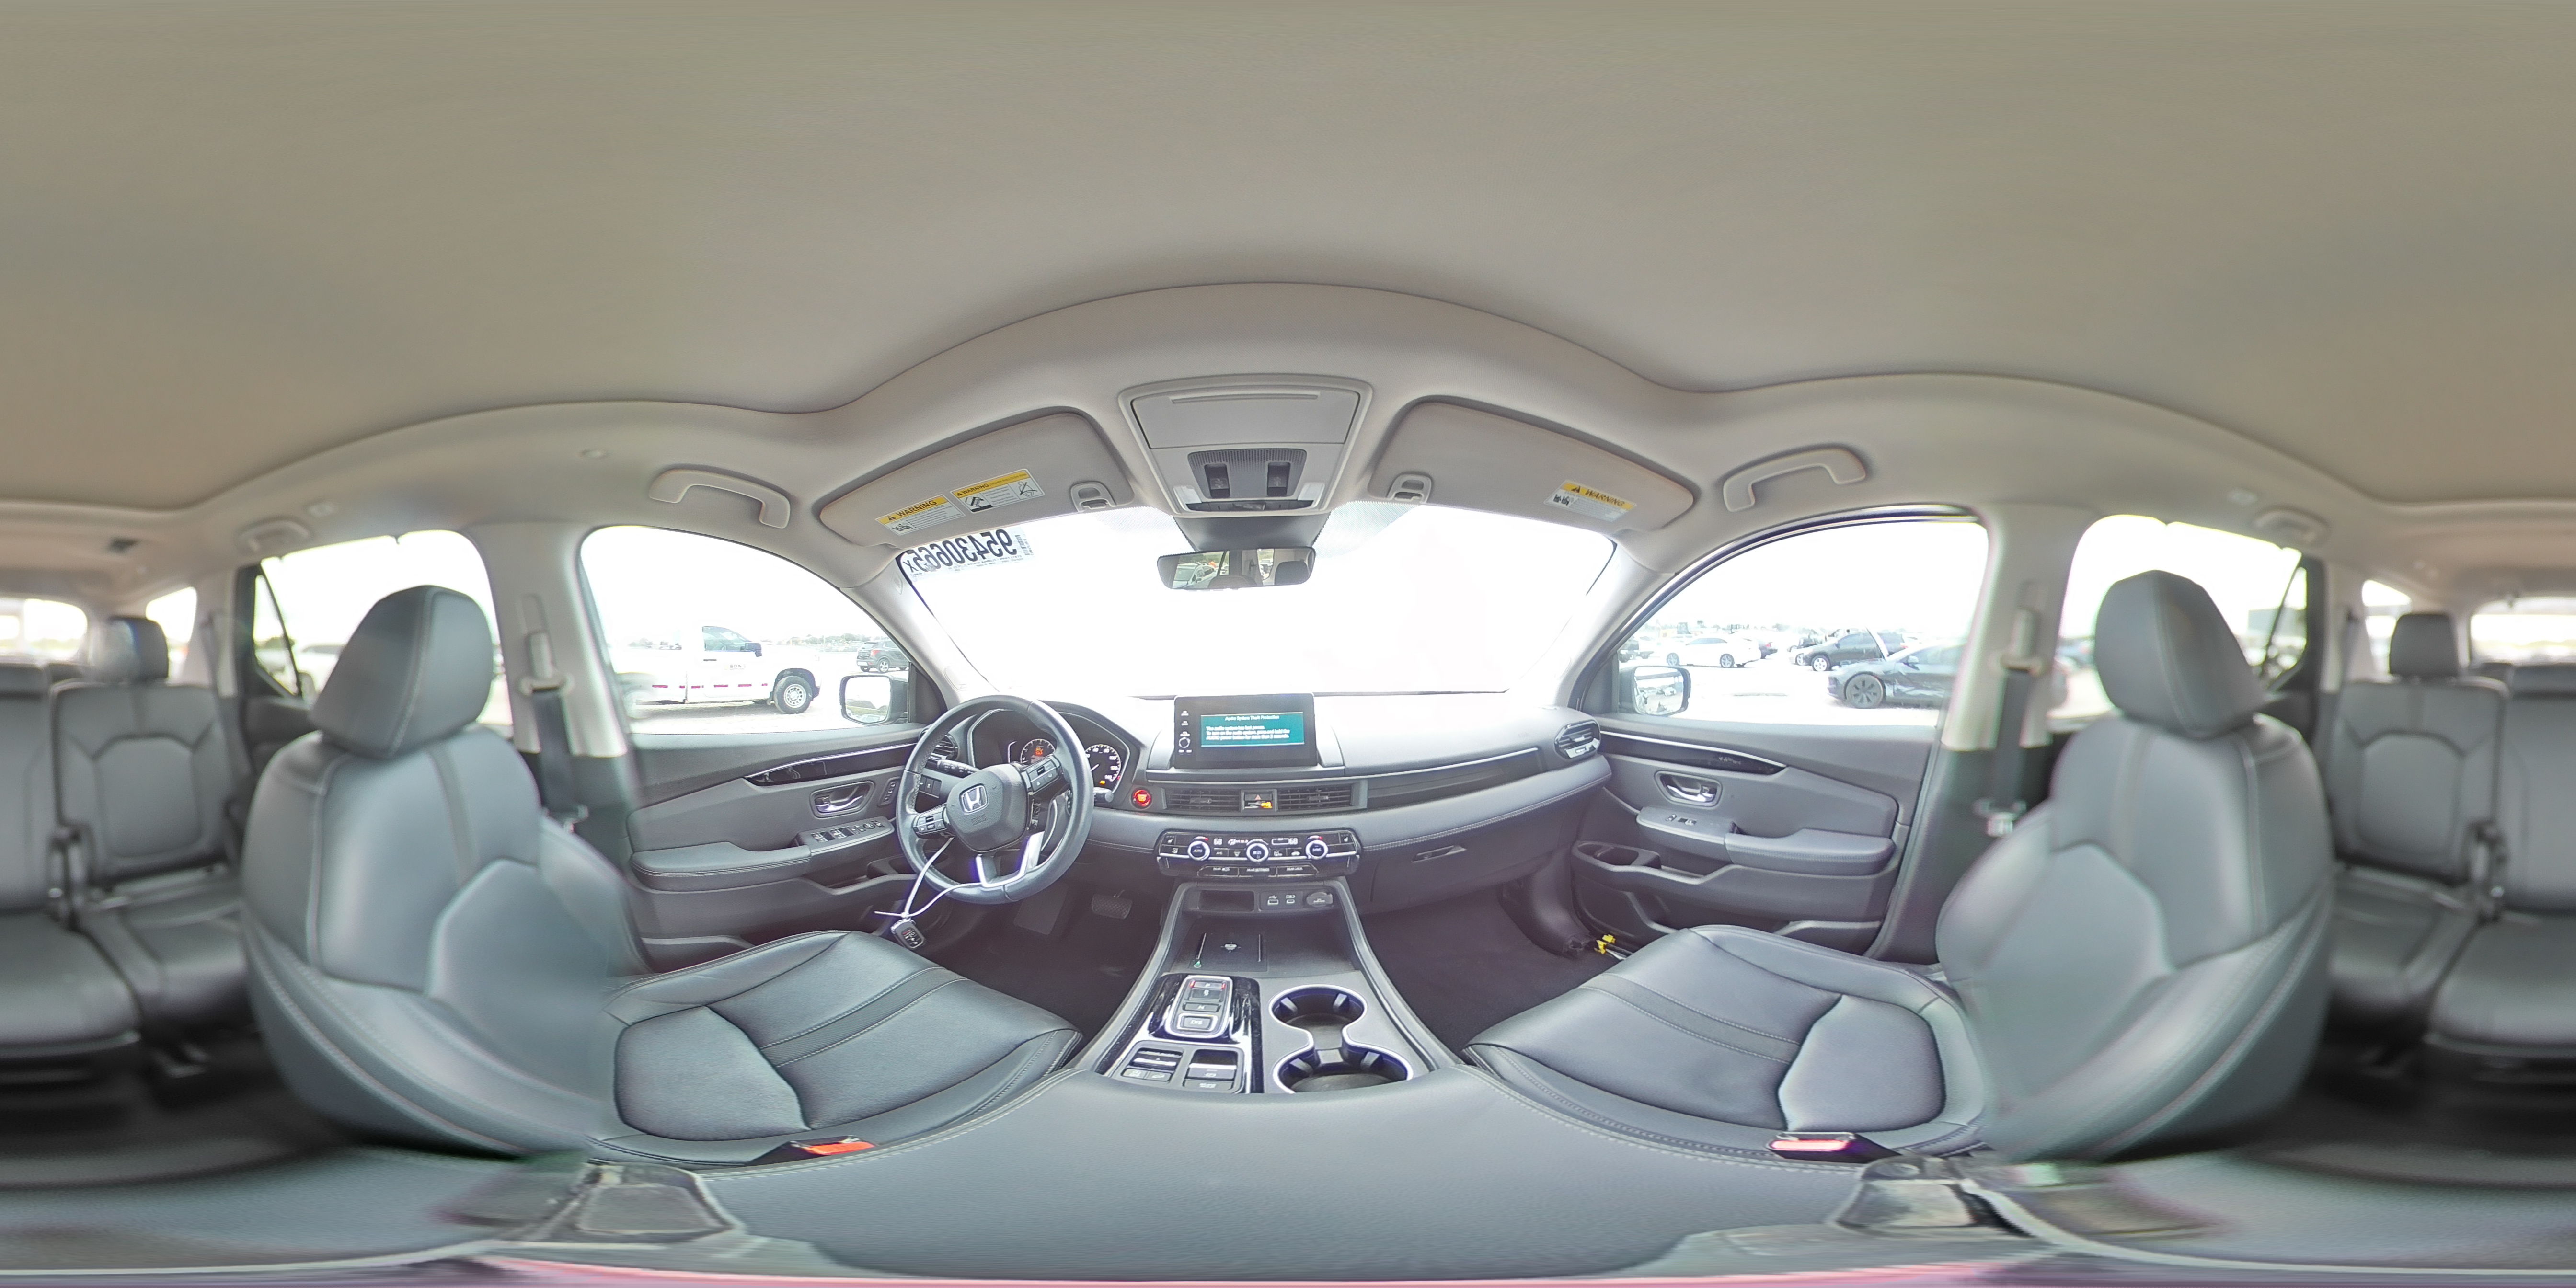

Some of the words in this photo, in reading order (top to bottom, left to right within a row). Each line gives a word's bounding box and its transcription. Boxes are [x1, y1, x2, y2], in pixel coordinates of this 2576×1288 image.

[961, 483, 990, 494] WARNING
[1585, 489, 1625, 506] WARNING
[896, 500, 937, 517] WARNING
